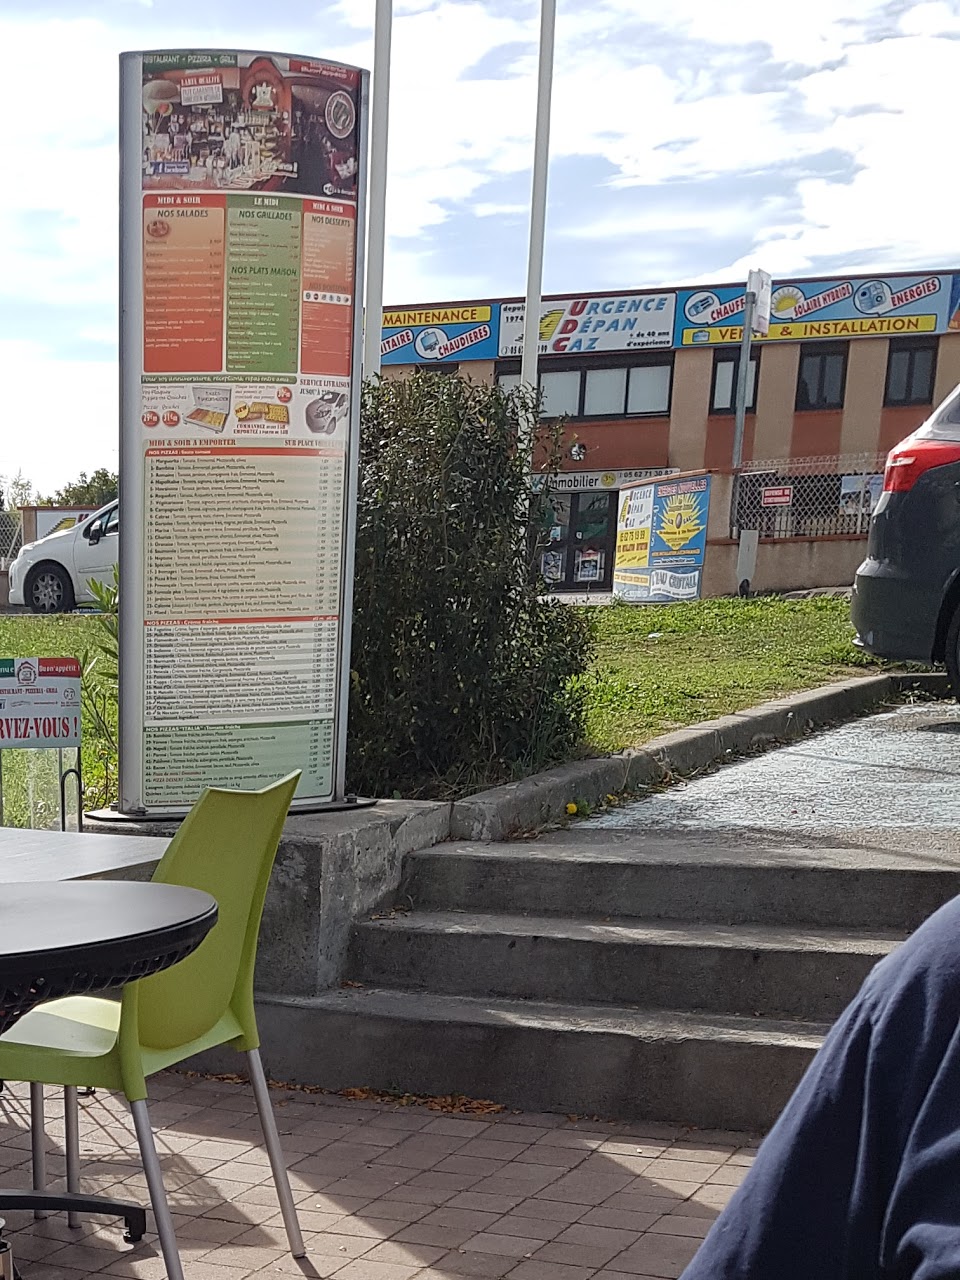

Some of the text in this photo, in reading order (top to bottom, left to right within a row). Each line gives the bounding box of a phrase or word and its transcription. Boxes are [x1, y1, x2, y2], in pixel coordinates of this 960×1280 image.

[254, 197, 279, 206] LE MIDI
[312, 203, 325, 211] MIDI
[330, 205, 344, 213] SOIR
[157, 209, 208, 218] NOS SALADES
[239, 210, 292, 221] NOS GRILLADES
[311, 215, 350, 228] NOS DESSERTS
[231, 266, 297, 276] NOS PLATS MAISON
[793, 283, 851, 317] SOLAIRE HYBRIDE
[890, 281, 937, 307] ENERGIES
[568, 298, 667, 317] URGENCE
[383, 308, 477, 326] MAINTENANCE
[558, 317, 638, 335] DÉPAN
[780, 326, 792, 336] &
[804, 317, 920, 336] INSTALLATION
[438, 326, 488, 356] CHAUDIERES
[552, 337, 599, 352] GAZ
[626, 338, 671, 347] d'expérience
[300, 378, 350, 389] SERVICE LIVRAISON
[149, 439, 164, 447] MIDI
[198, 439, 236, 447] EMPORTER
[284, 440, 317, 448] SUR PLACE
[73, 716, 78, 738] !
